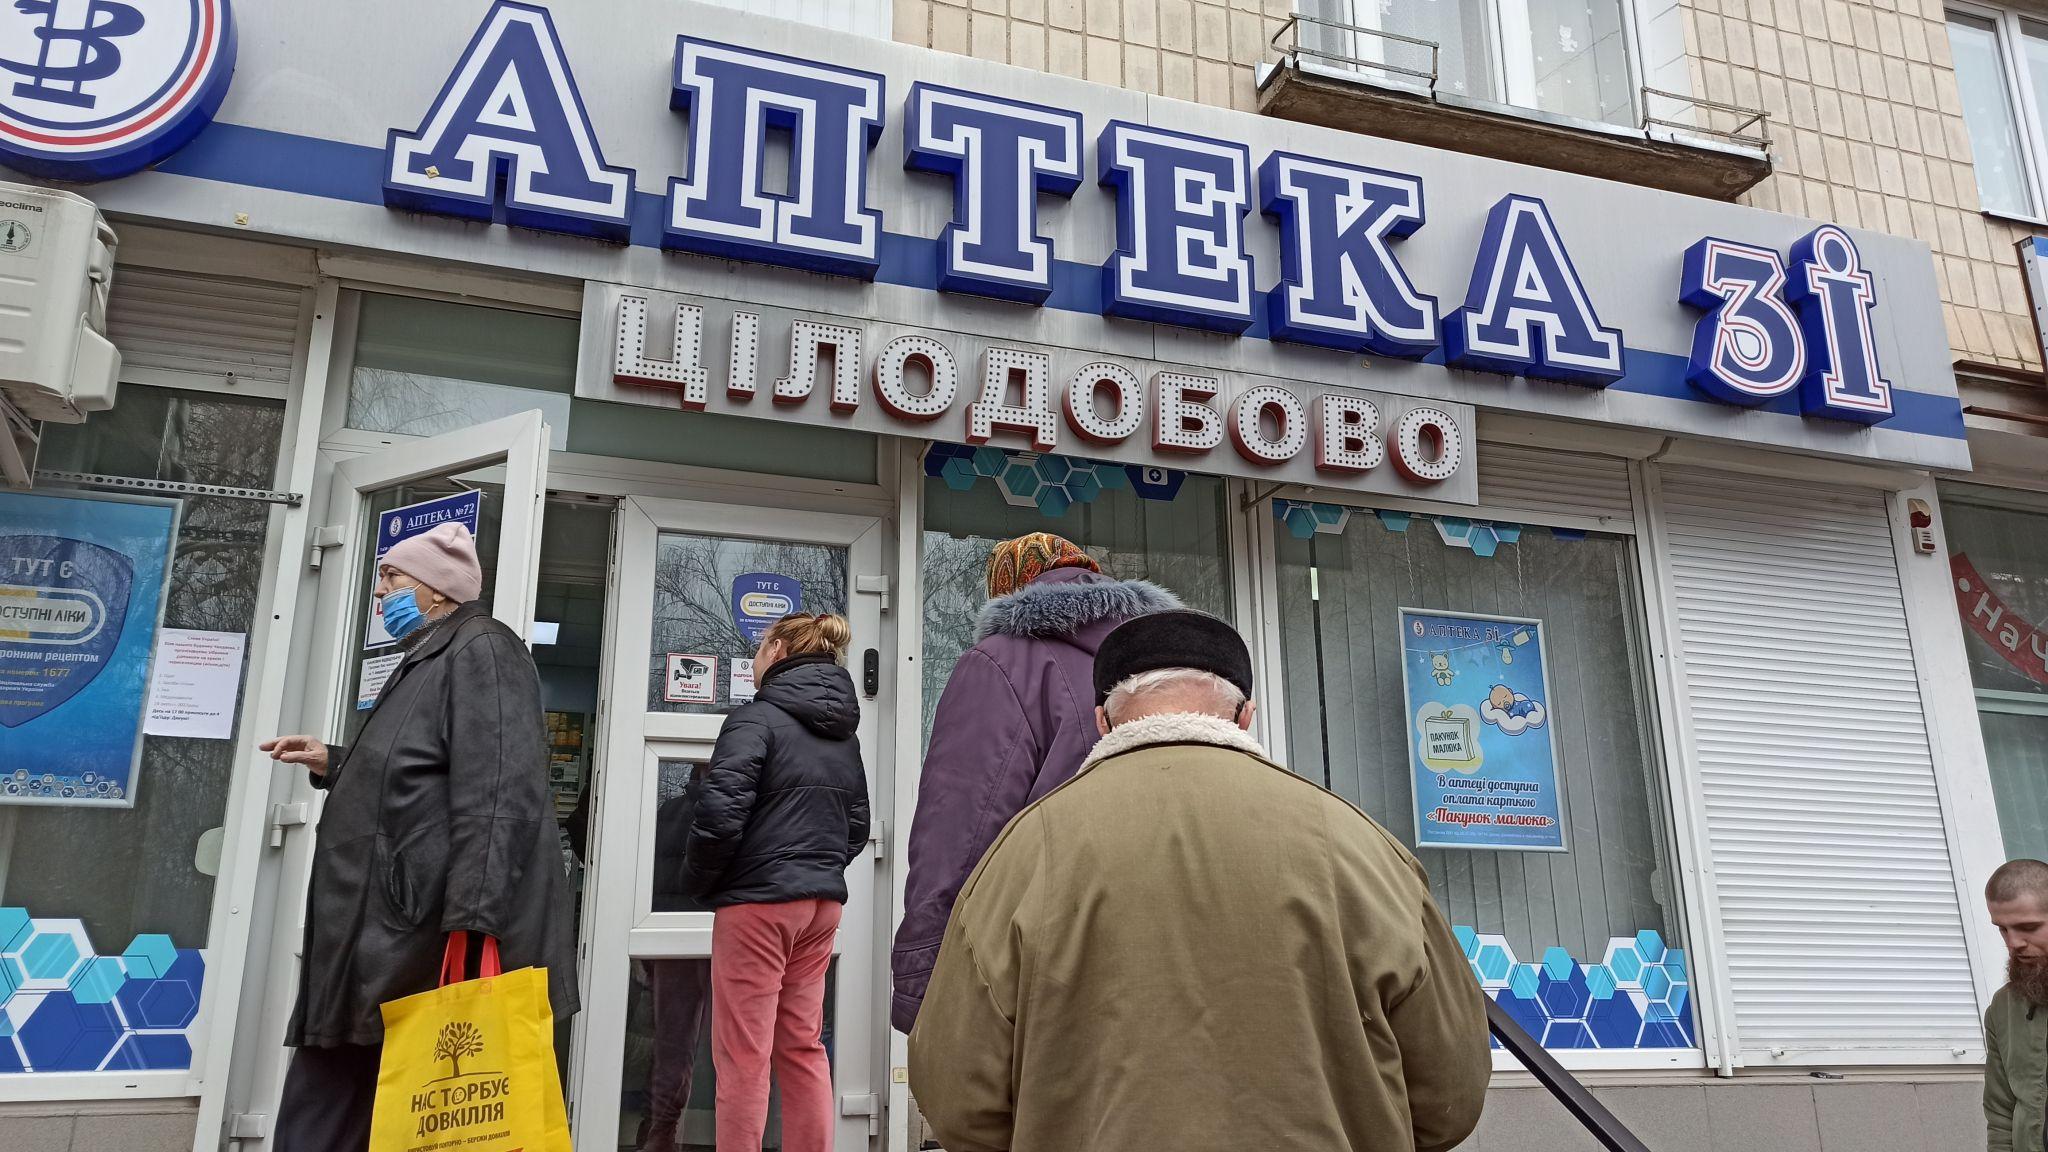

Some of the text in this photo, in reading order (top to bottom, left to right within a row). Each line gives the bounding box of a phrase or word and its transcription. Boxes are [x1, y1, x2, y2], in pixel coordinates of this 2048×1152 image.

[384, 1, 1624, 388] АПТЕКА
[613, 294, 1462, 484] ЦІЛОДОБОВО
[406, 508, 451, 529] АПТЕКА
[11, 557, 74, 579] ТУТ Є
[756, 581, 772, 590] ТУТ
[0, 606, 86, 624] СТУПНІ ЛІКИ
[1428, 624, 1480, 641] АПТЕКА
[44, 651, 99, 663] рецептом
[43, 667, 71, 678] 1677
[679, 681, 702, 690] Увага!
[1430, 730, 1460, 743] ПАКУНОК
[1432, 742, 1463, 755] МАЛЮКА
[1436, 774, 1540, 795] В аптеці доступна
[1442, 792, 1537, 811] оплата карткою
[1426, 807, 1556, 827] «Пакунок малюка»
[410, 1076, 511, 1114] НАС ТОРБУЄ
[415, 1101, 505, 1140] ДОВКІЛЛЯ
